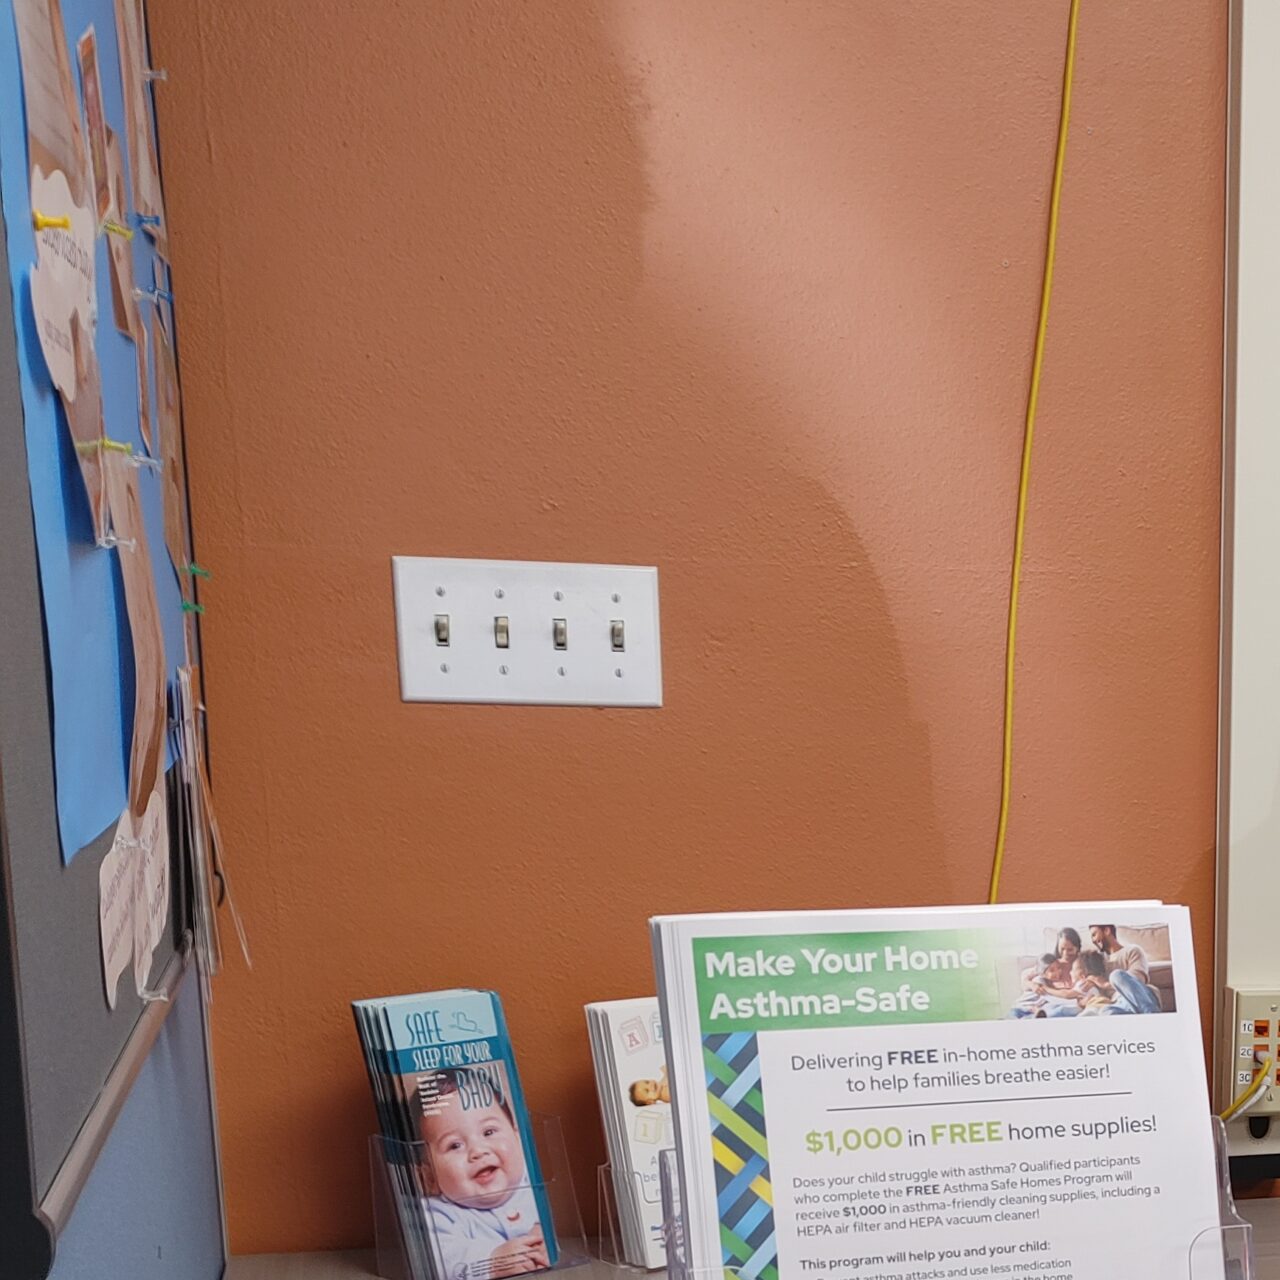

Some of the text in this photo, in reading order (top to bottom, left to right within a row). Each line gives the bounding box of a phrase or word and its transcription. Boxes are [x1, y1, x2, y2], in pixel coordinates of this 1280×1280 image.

[705, 946, 979, 978] Make Your Home
[709, 984, 931, 1020] Asthma-Safe
[405, 1010, 446, 1046] SAFE
[412, 1040, 493, 1071] SLEEP FOR YOUR
[791, 1039, 1156, 1071] Delivering FREE in-home asthma services
[456, 1063, 505, 1111] BABY
[846, 1063, 1110, 1093] to help families breathe easier!
[805, 1114, 1157, 1156] $1,000 in FREE home supplies!
[792, 1155, 1141, 1189] Does your child struggle with asthma? Qualified participants
[794, 1171, 1133, 1205] who complete the FREE Asthma Safe Homes Program will
[795, 1185, 1161, 1221] receive $1,000 in asthma-friendly cleaning supplies, including a
[796, 1209, 1040, 1237] HEPA air filter and HEPA vacuum cleaner!
[800, 1241, 1051, 1270] This program will help you and your child:
[905, 1269, 945, 1280] attacks
[947, 1267, 967, 1277] and
[970, 1266, 988, 1275] use
[990, 1264, 1011, 1274] less
[1013, 1259, 1071, 1272] medication
